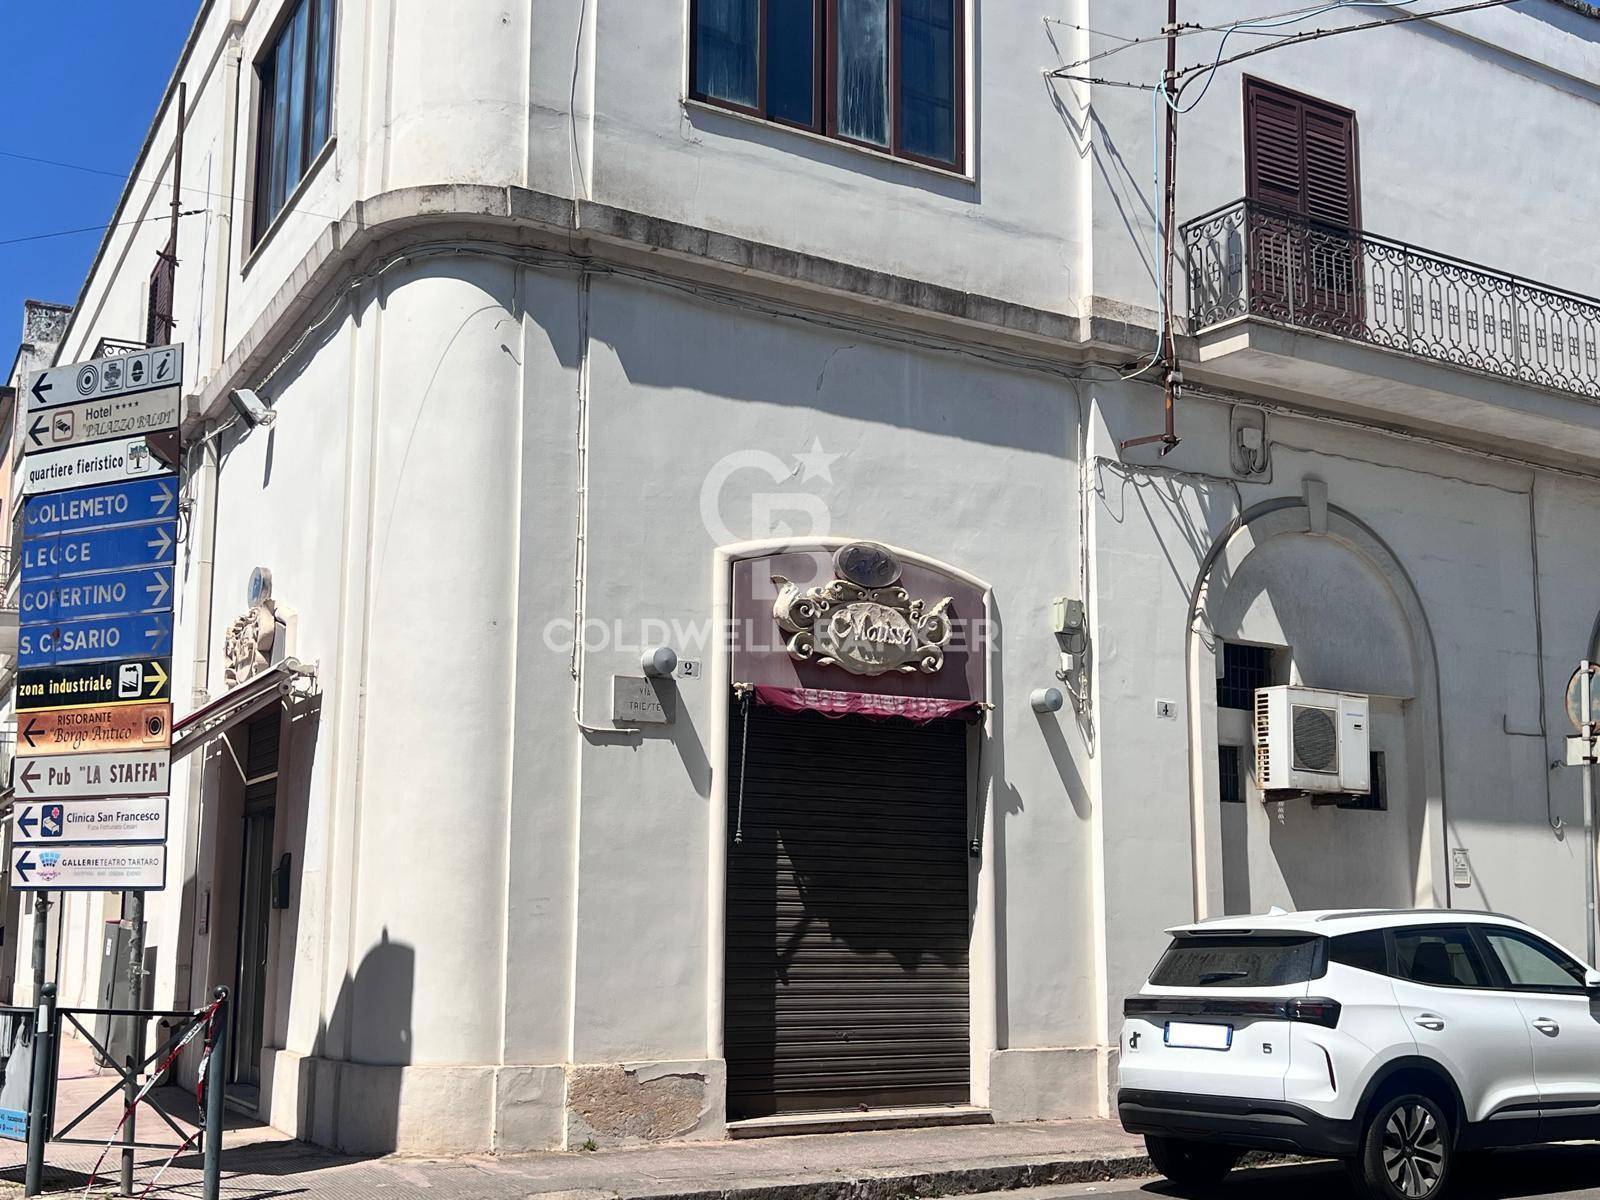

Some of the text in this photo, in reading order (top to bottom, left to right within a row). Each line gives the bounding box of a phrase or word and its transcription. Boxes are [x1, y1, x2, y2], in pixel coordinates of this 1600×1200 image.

[86, 404, 112, 420] Hotel
[30, 454, 124, 484] quartiere fieristico
[27, 493, 128, 524] COLLEMETO
[25, 542, 91, 568] LECCE
[828, 609, 912, 646] Mousse
[20, 635, 34, 655] S.
[684, 662, 692, 676] 2
[19, 674, 112, 696] zona industriale
[639, 687, 651, 697] VIA
[1162, 703, 1169, 716] 4
[57, 711, 112, 726] RISTORANTE
[48, 762, 165, 786] Pub "LA STAFFA"
[66, 811, 160, 823] Clinica San Francesco
[62, 858, 159, 867] GALLERIE TEATRO TARTARO
[1262, 1042, 1272, 1054] 5
